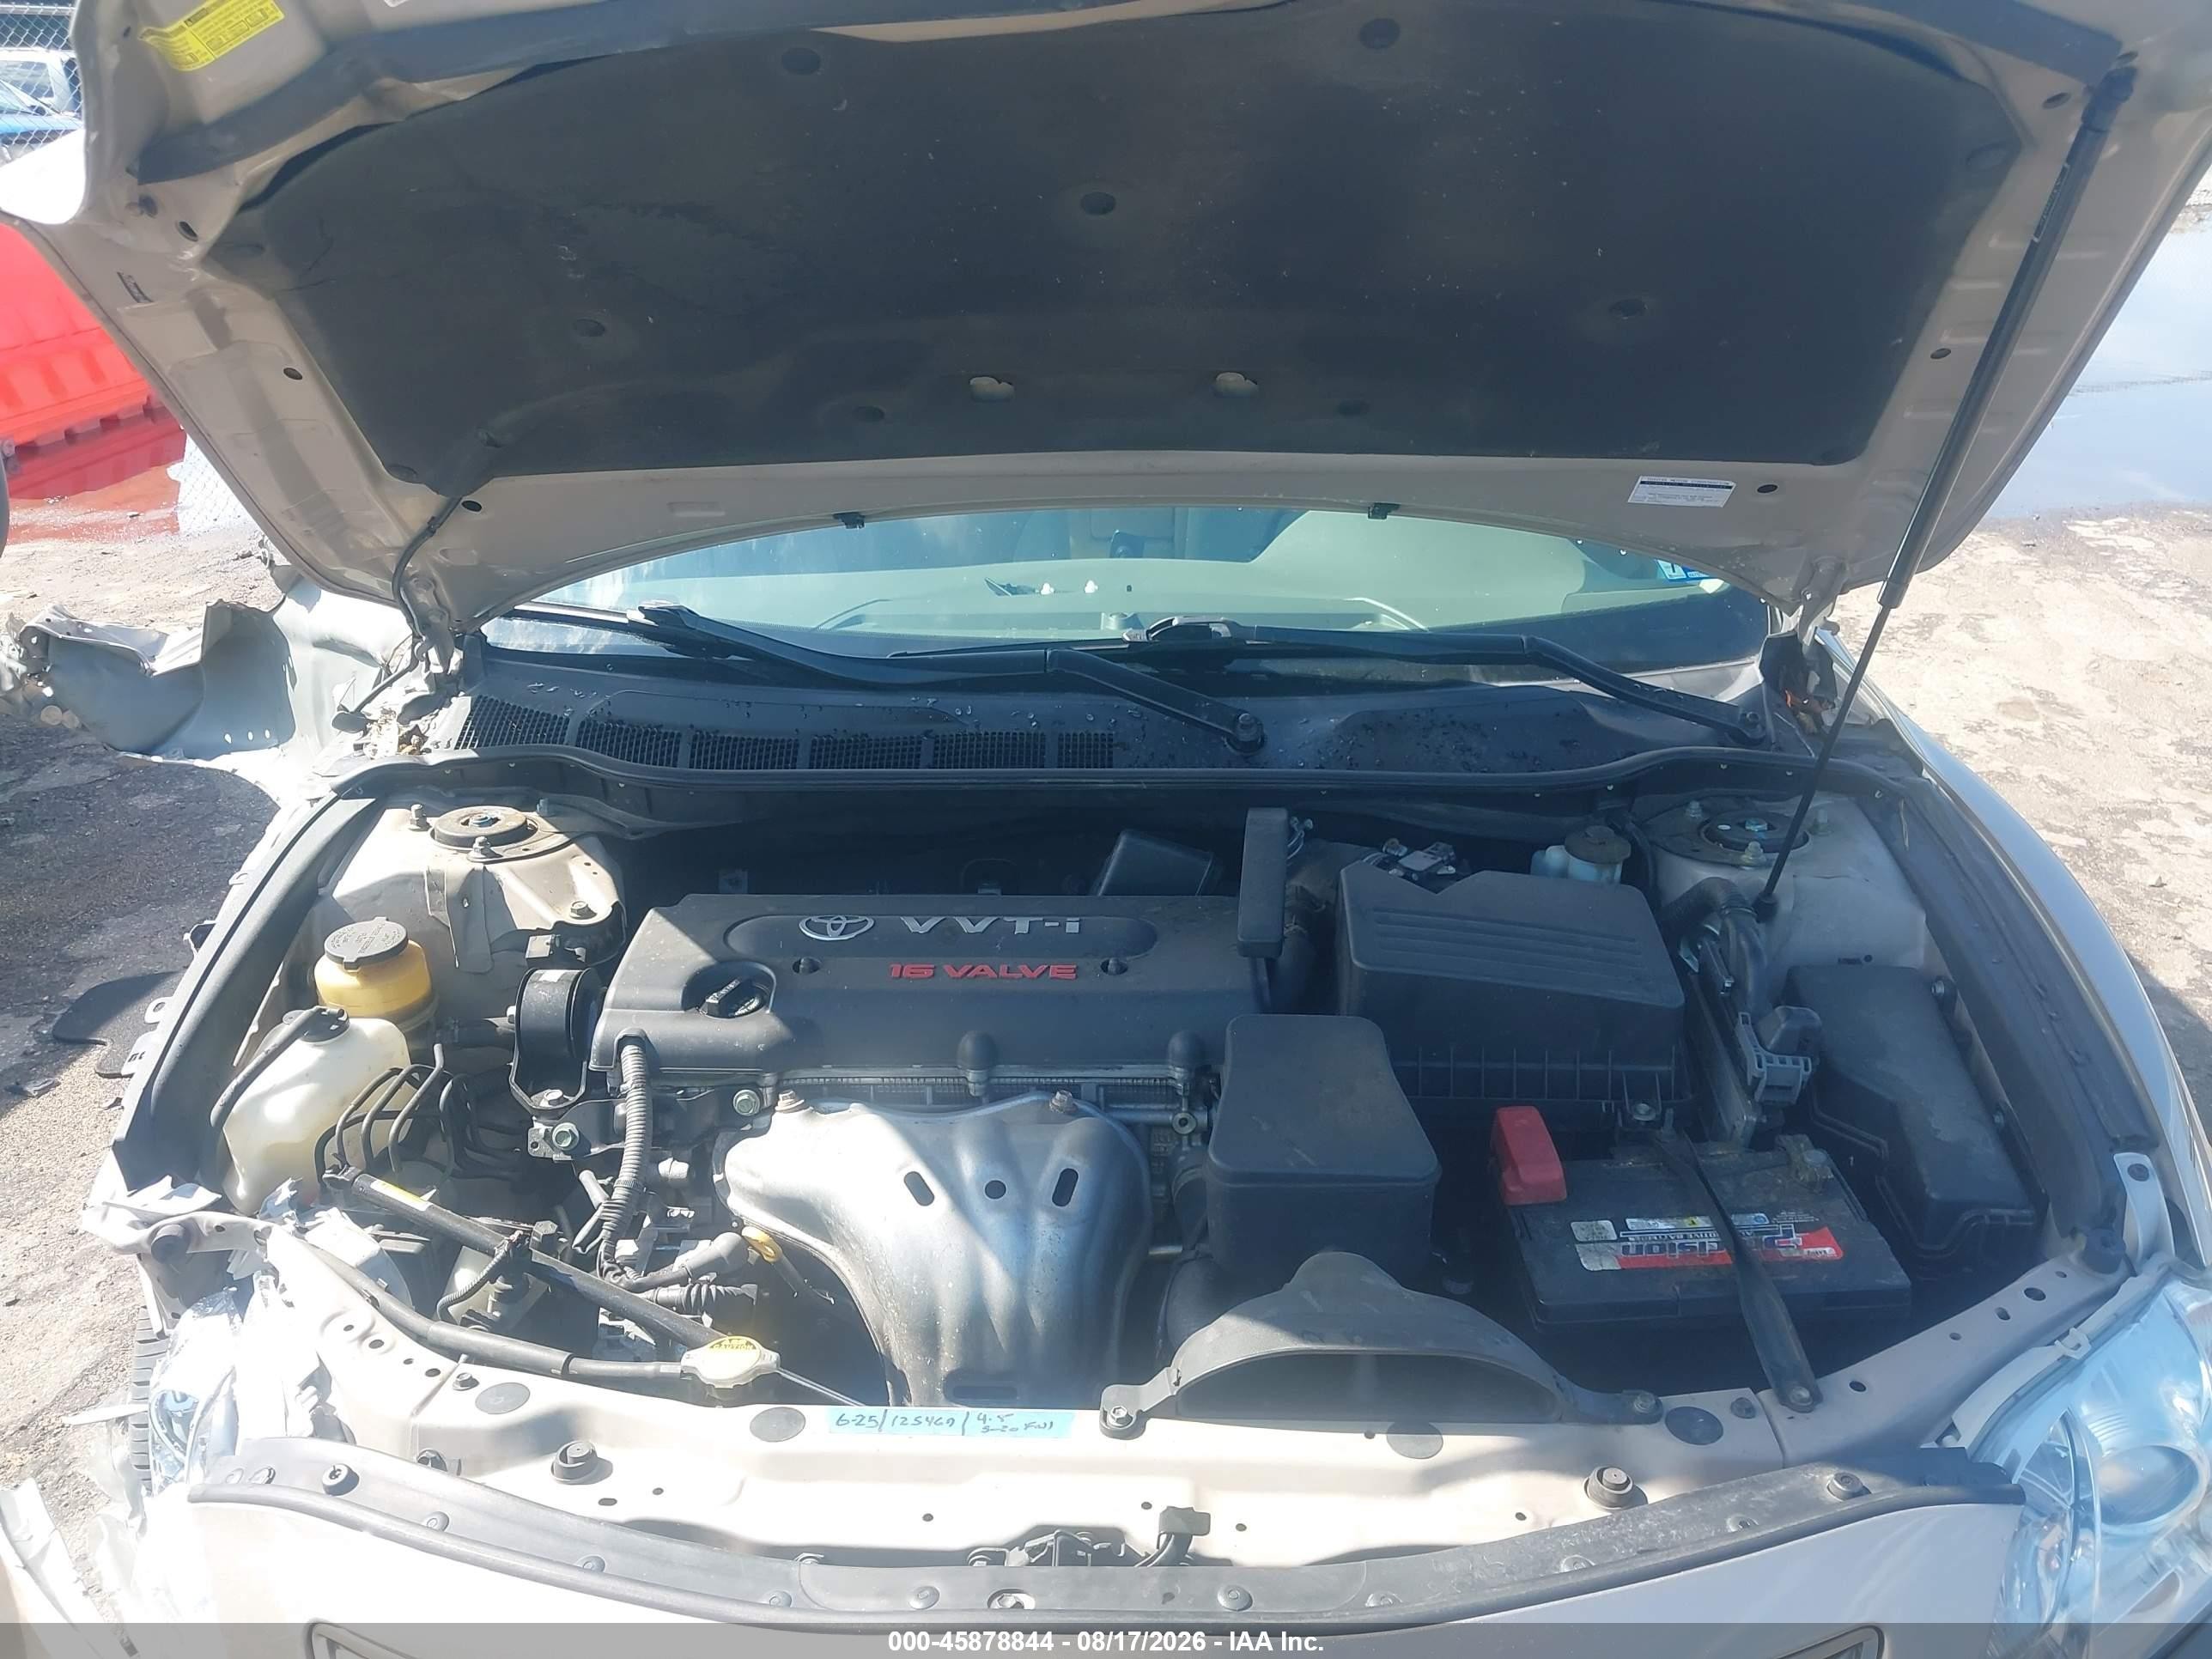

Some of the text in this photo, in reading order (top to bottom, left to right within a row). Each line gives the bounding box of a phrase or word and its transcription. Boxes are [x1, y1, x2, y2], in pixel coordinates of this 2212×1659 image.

[900, 916, 1079, 934] VVT-i
[890, 963, 1079, 980] 16 VALVE
